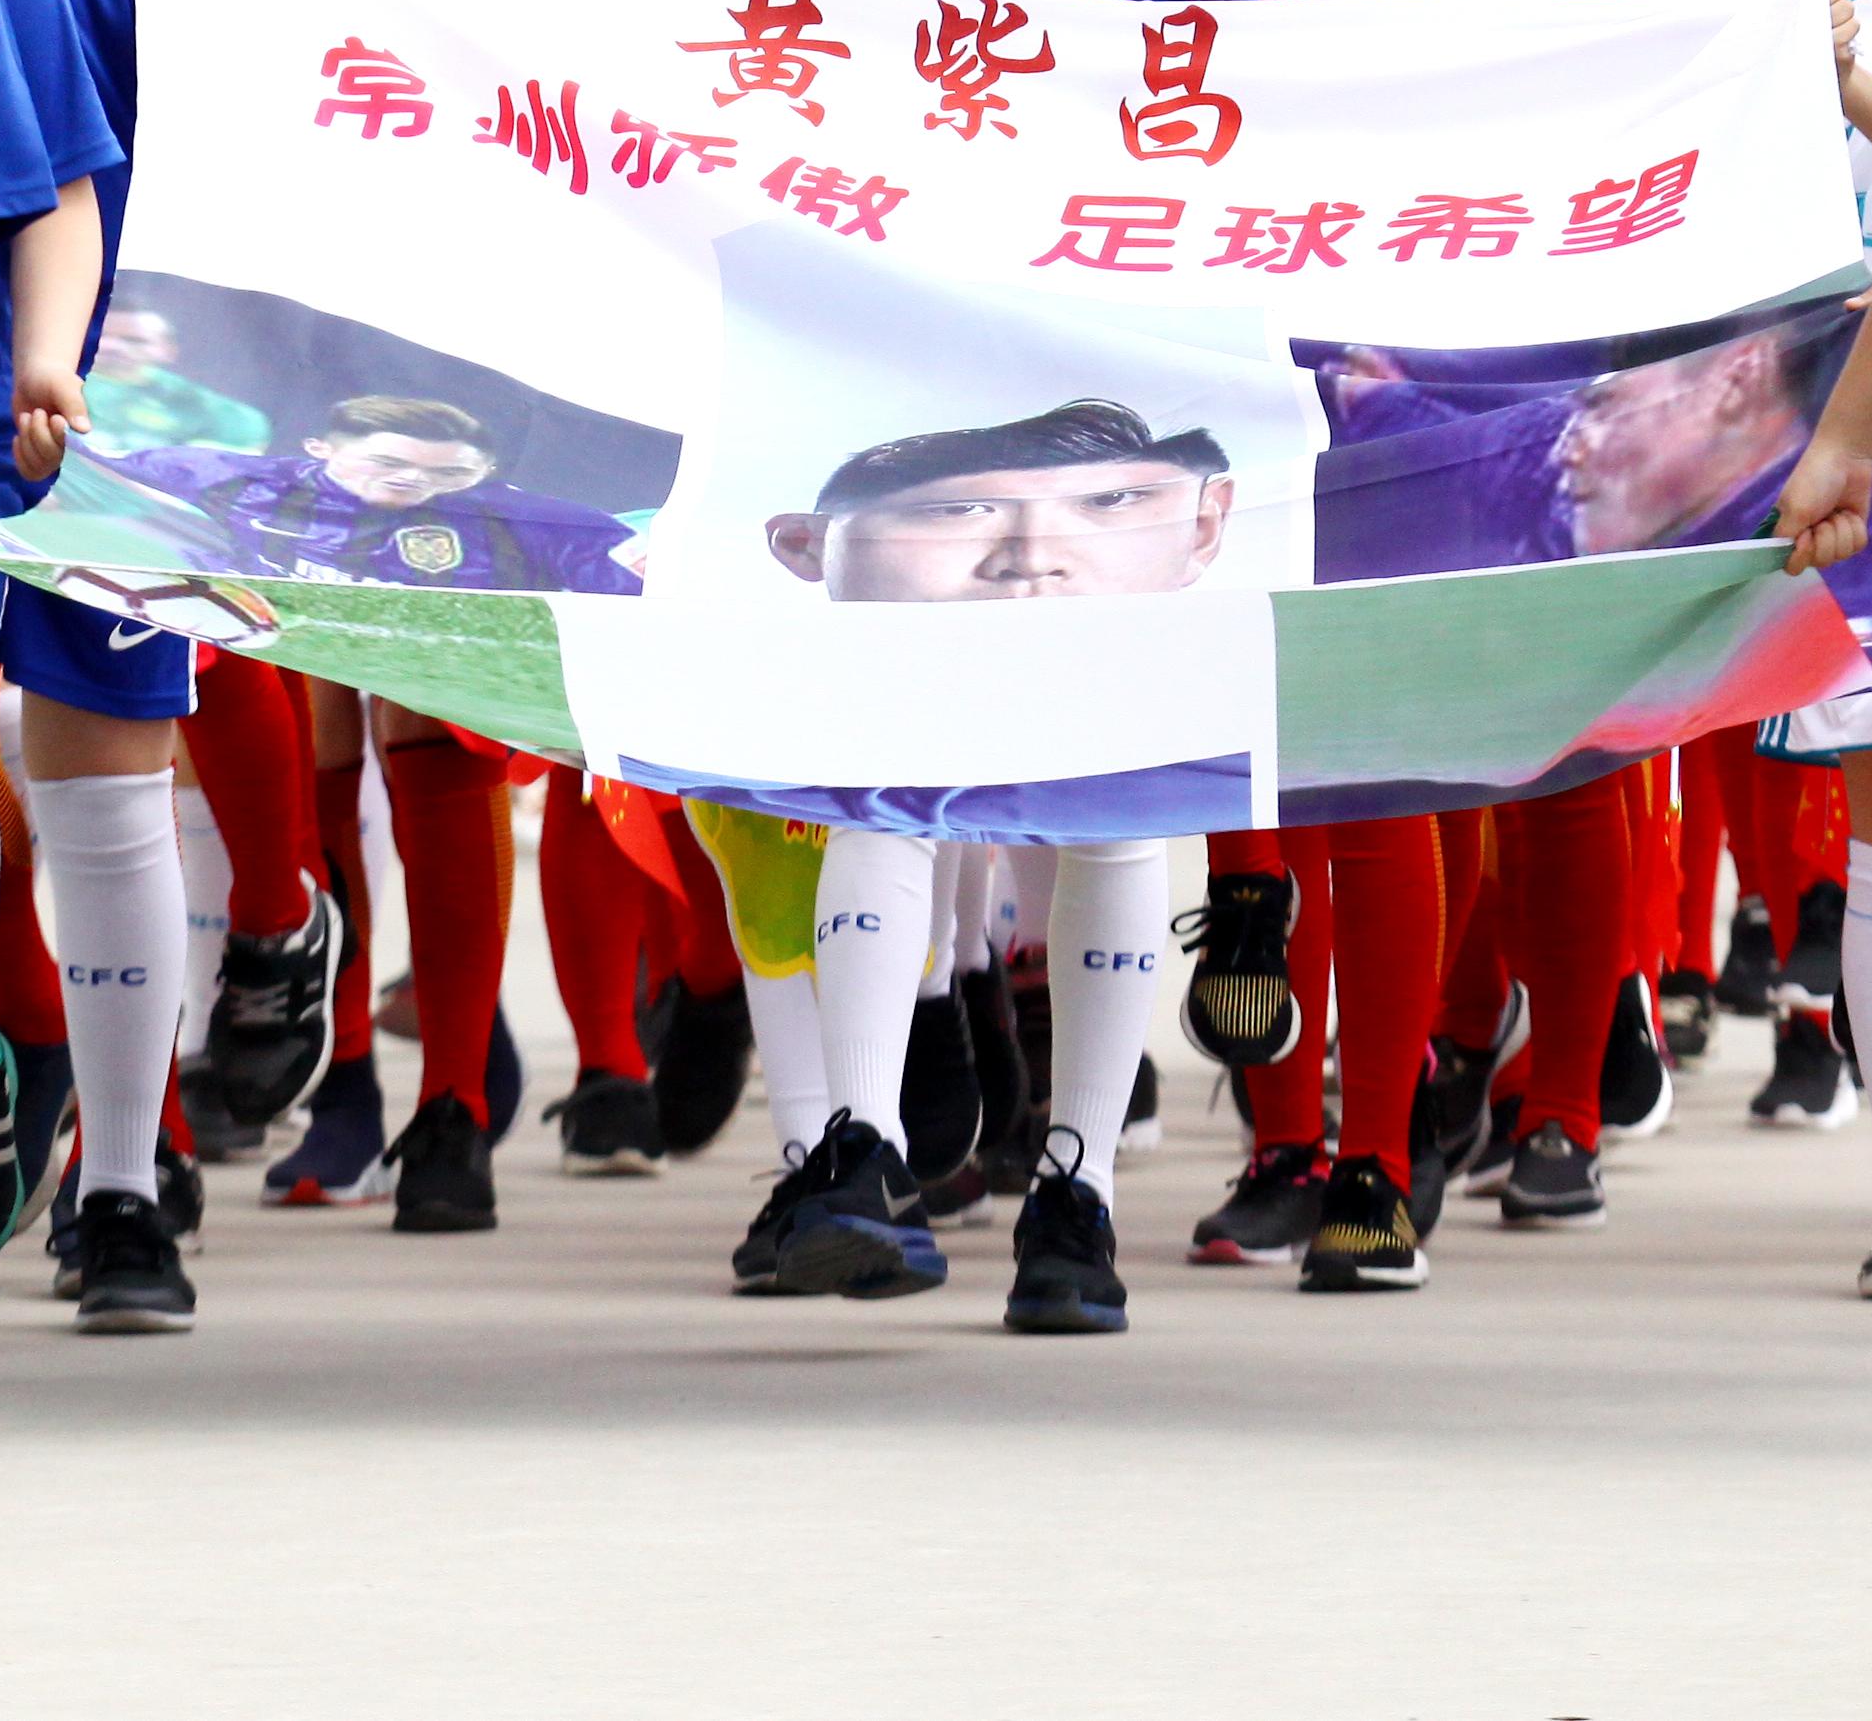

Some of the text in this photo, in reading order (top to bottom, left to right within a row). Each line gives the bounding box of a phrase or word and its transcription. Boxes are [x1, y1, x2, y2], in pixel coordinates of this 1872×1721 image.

[1031, 148, 1700, 274] 足球希望
[817, 911, 882, 944] CFC
[1083, 948, 1156, 973] CFC
[67, 964, 149, 988] CFC
